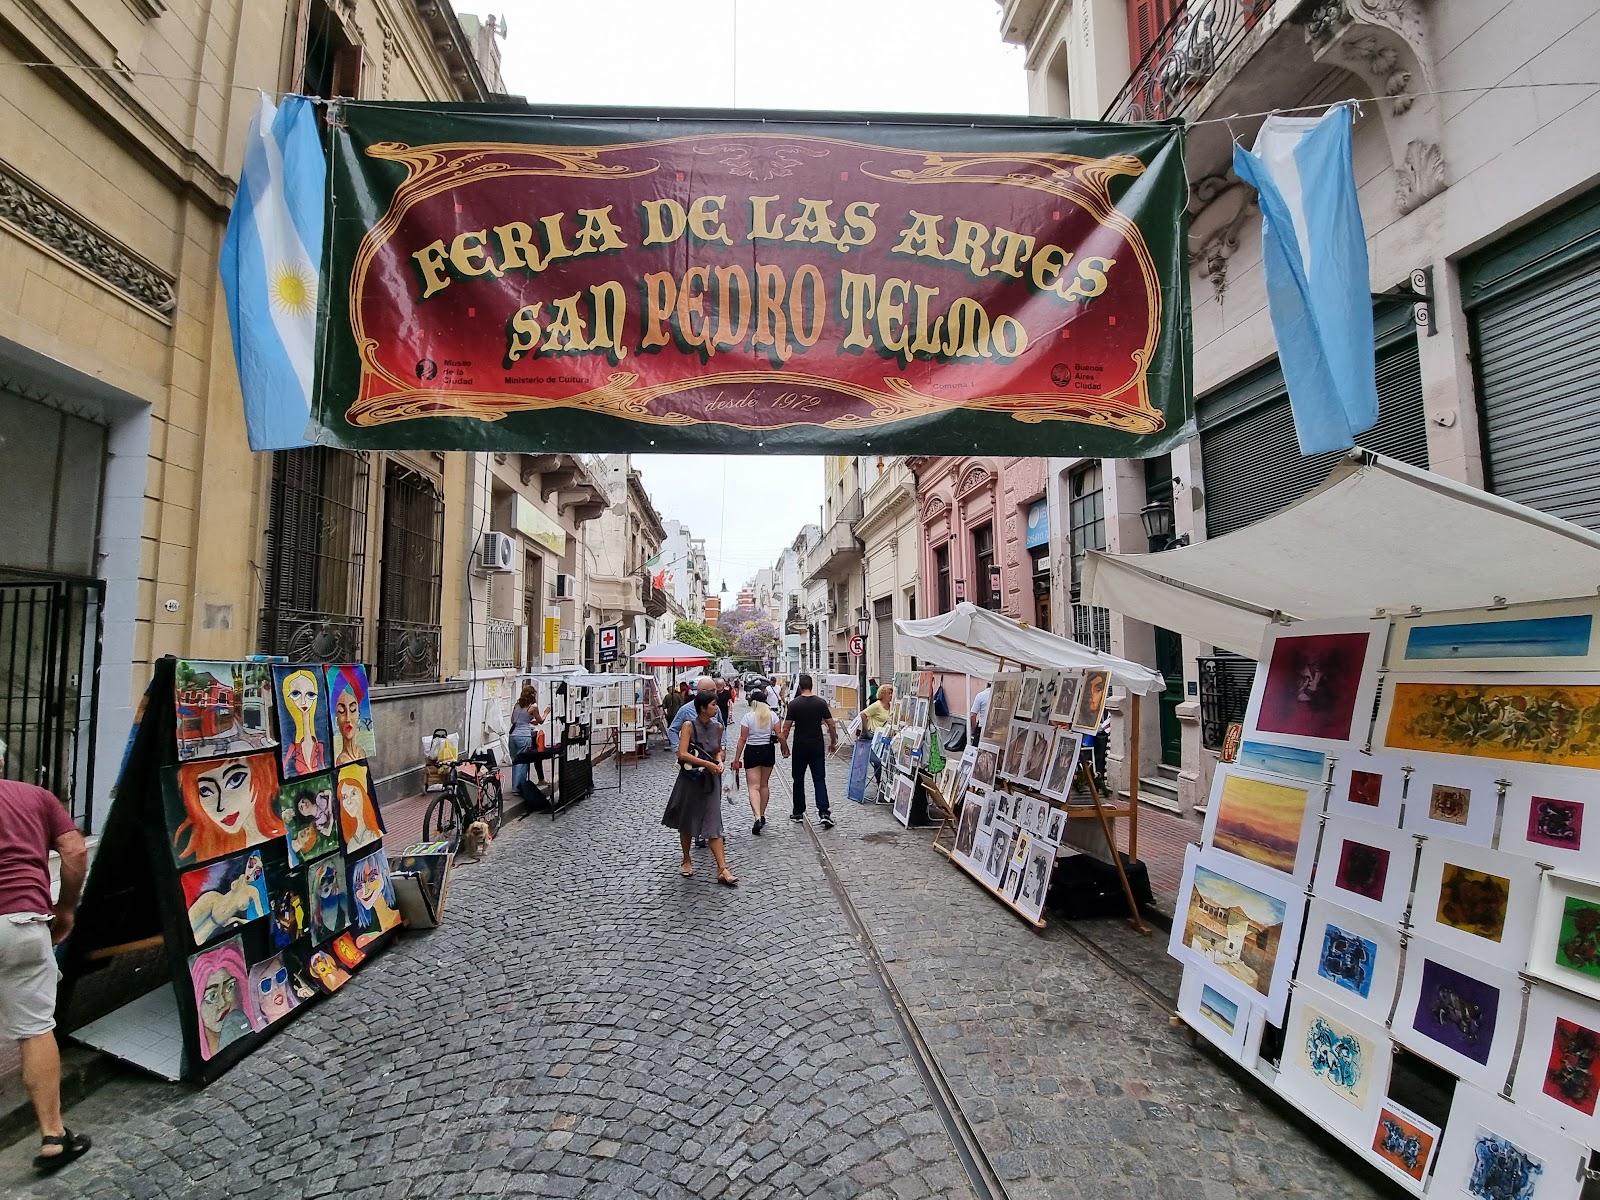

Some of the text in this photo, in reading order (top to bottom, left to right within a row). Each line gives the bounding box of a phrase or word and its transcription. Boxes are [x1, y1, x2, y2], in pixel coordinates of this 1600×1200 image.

[411, 194, 1117, 302] FERIA DE LAS ARTES
[508, 262, 1029, 363] SAN PEDRO TELMO
[443, 359, 472, 367] Museo
[1074, 363, 1103, 372] Buenos
[443, 376, 473, 385] Ciudad
[504, 376, 590, 385] Ministerio de Cultura
[1074, 373, 1095, 381] Aires
[933, 382, 968, 390] Comuna
[1074, 382, 1102, 390] Ciudad
[704, 388, 822, 412] desde 1972
